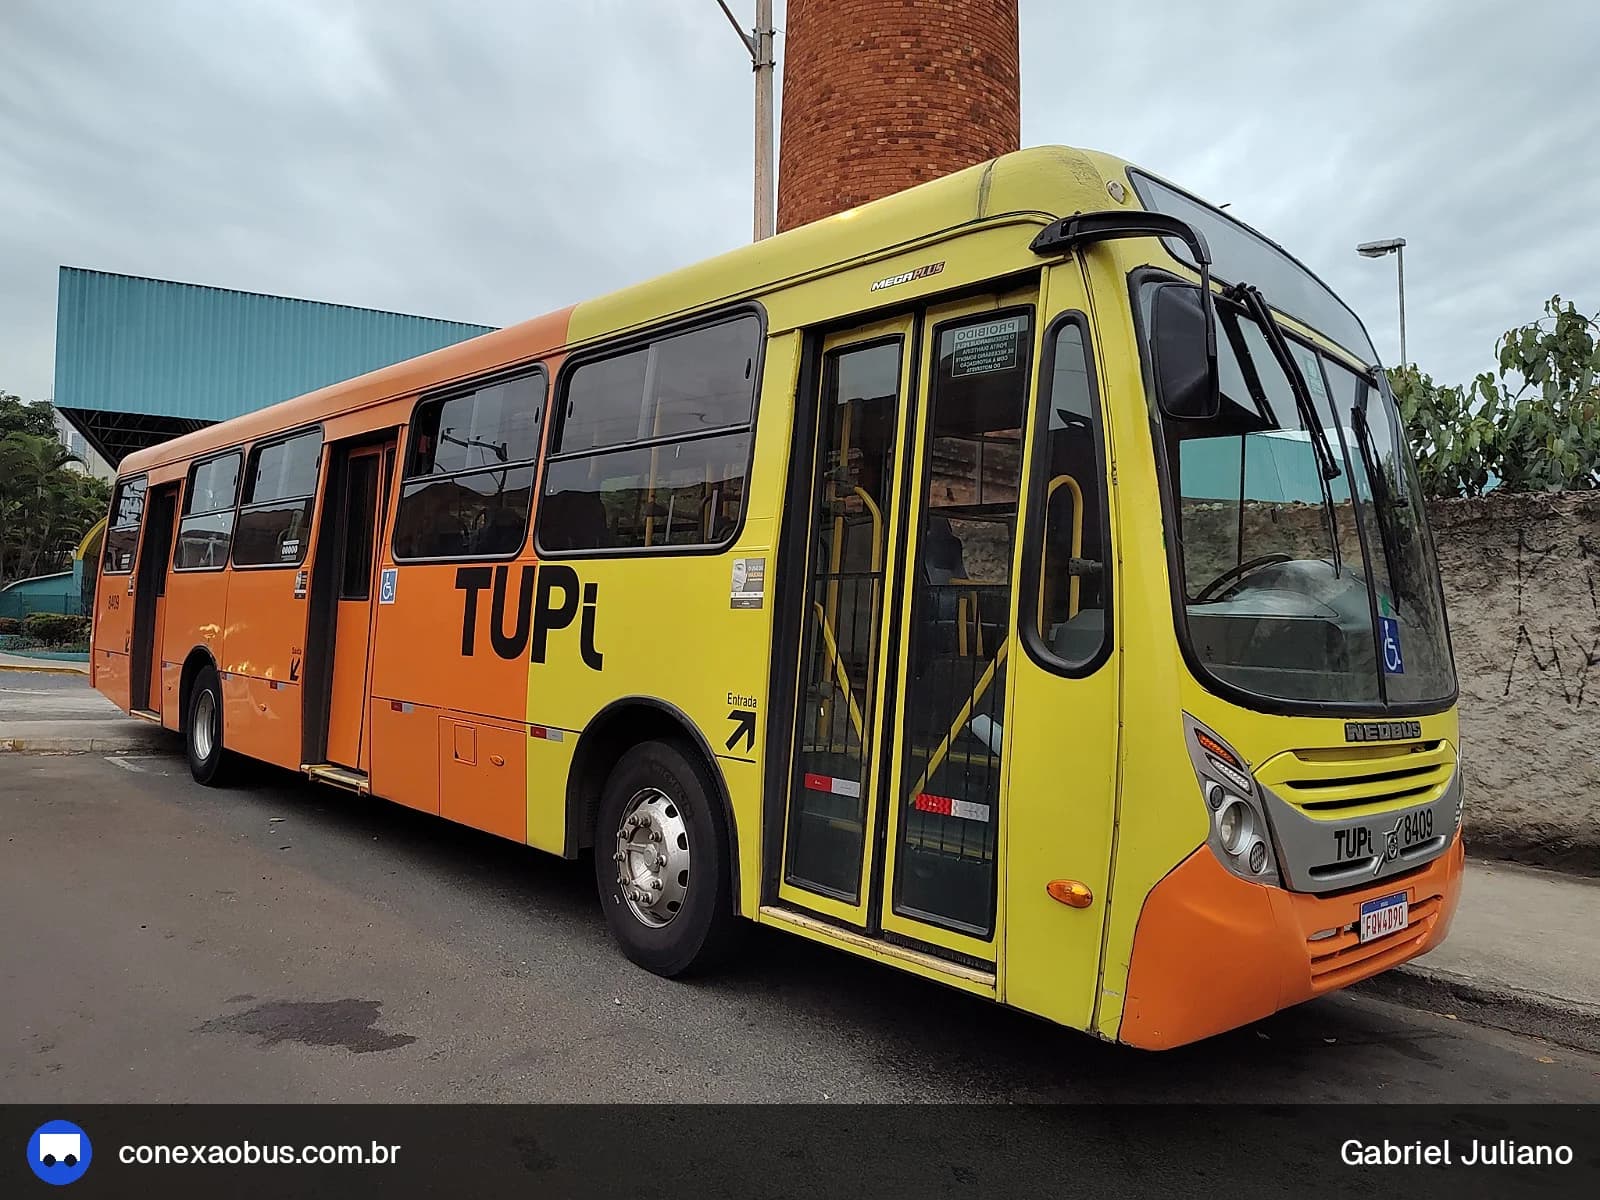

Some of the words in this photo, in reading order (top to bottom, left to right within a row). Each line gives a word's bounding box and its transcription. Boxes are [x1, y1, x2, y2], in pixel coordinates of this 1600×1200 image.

[727, 692, 757, 708] Entrada
[1345, 722, 1421, 742] NEOBUS
[1404, 808, 1433, 845] 8409
